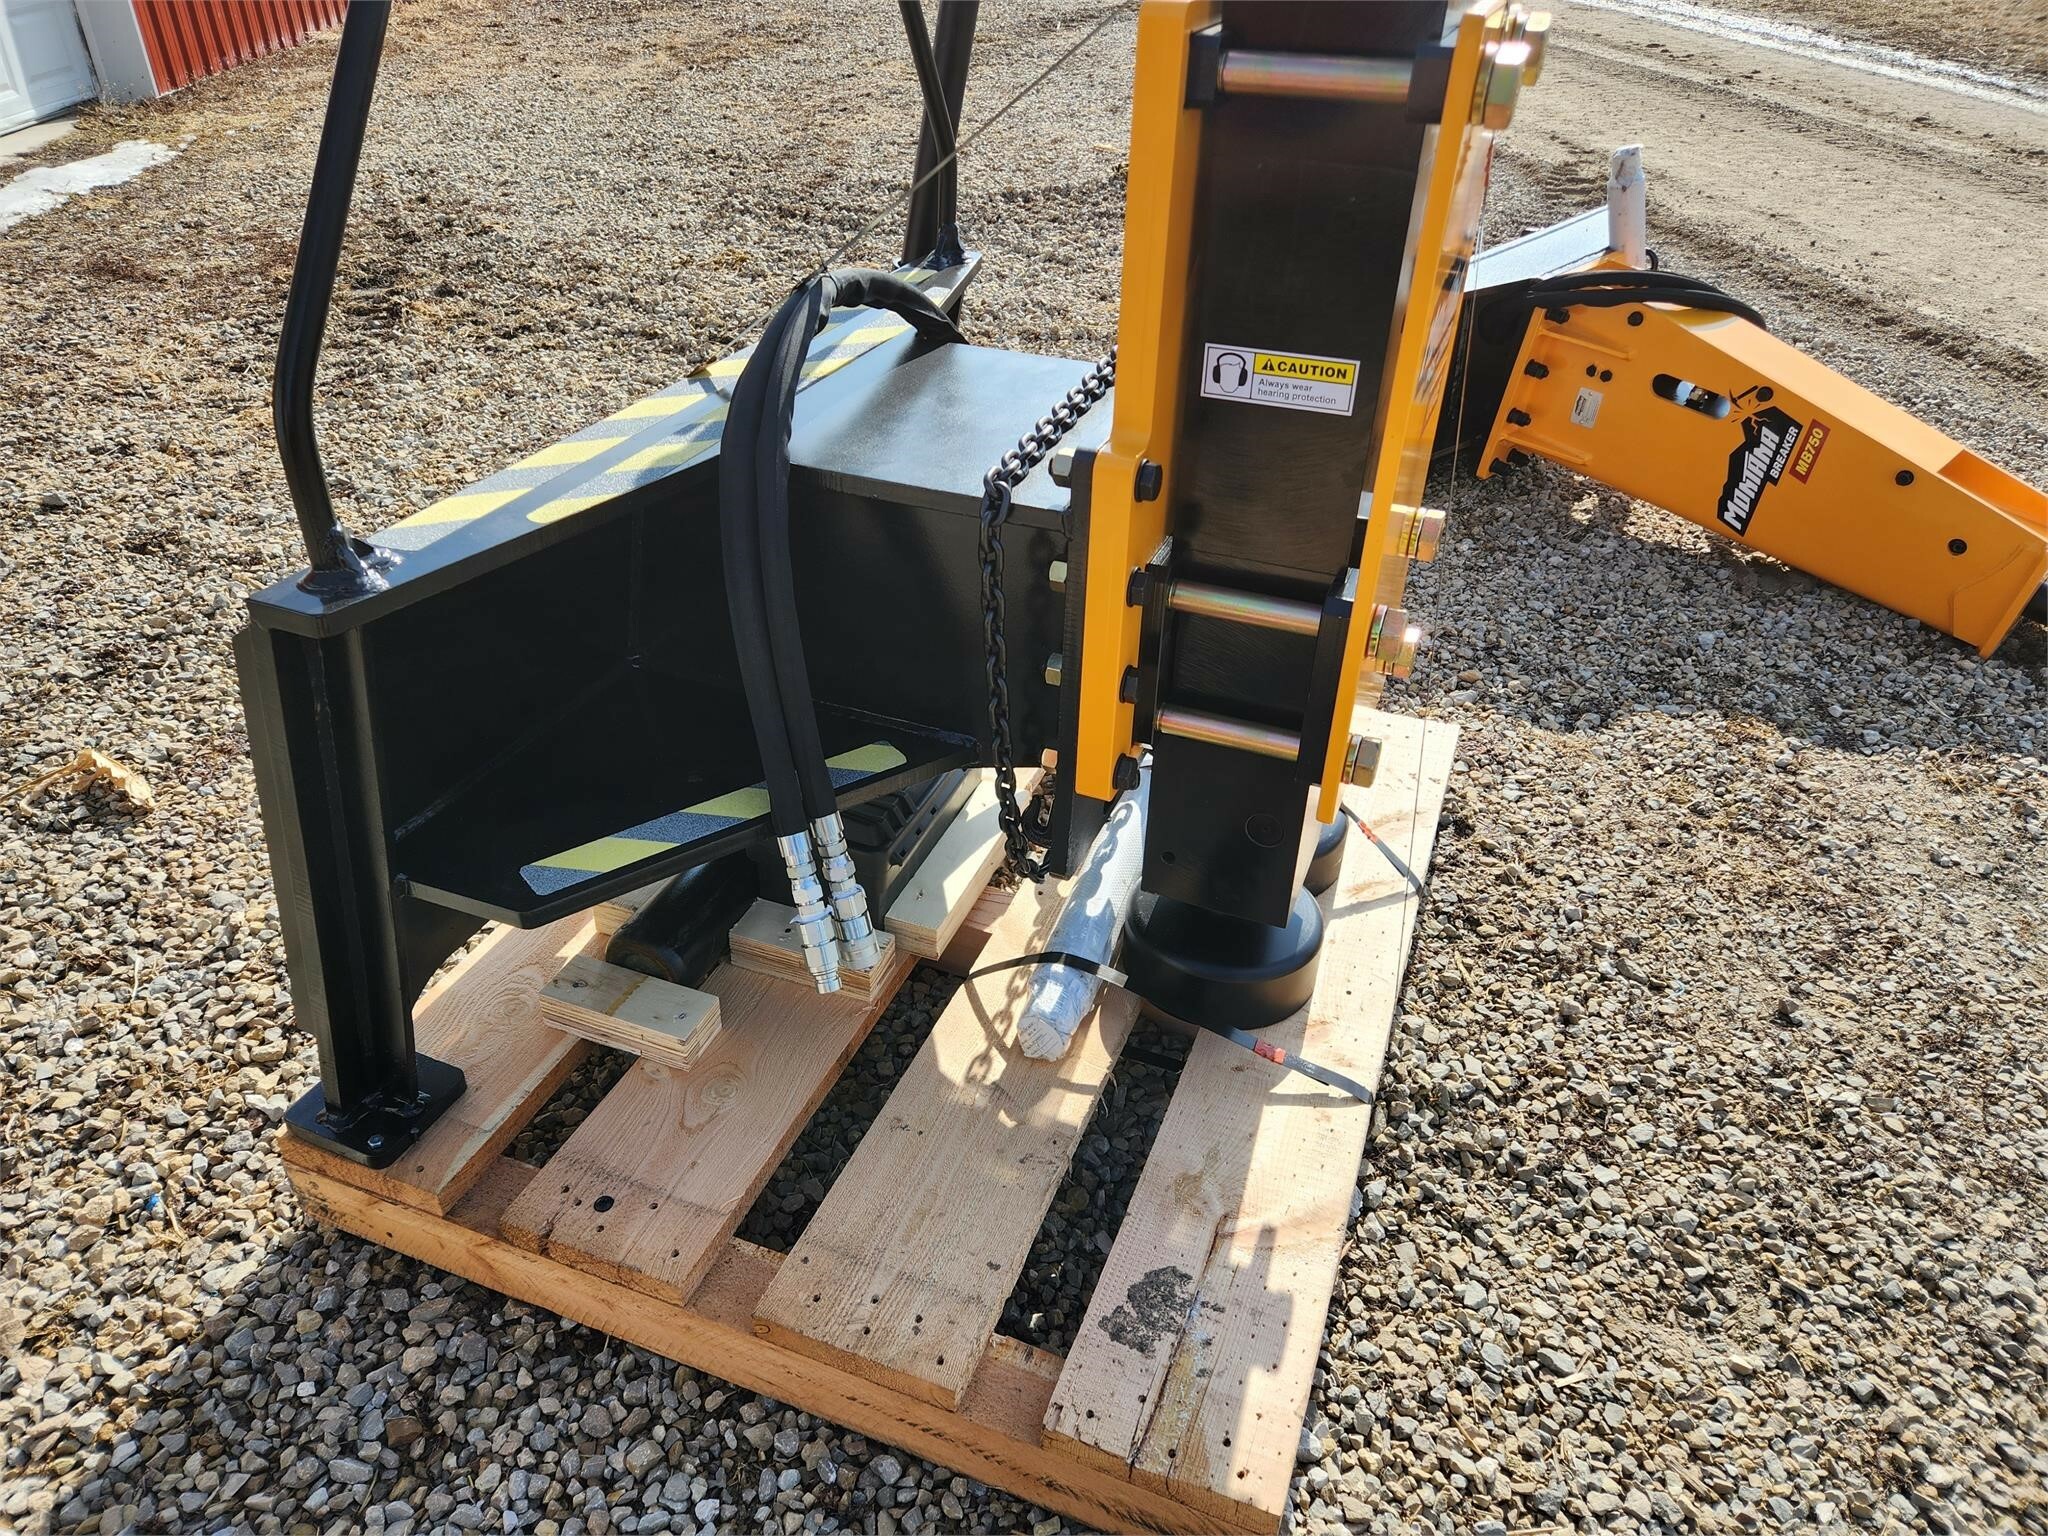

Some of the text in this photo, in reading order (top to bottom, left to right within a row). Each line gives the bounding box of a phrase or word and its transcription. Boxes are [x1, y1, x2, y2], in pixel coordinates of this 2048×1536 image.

[1258, 378, 1313, 391] Always wear
[1277, 361, 1348, 379] CAUTION
[1257, 388, 1337, 404] hearing protection
[1769, 425, 1799, 479] BREAKER
[1795, 427, 1824, 475] MB750
[1723, 425, 1780, 530] MONTANA
